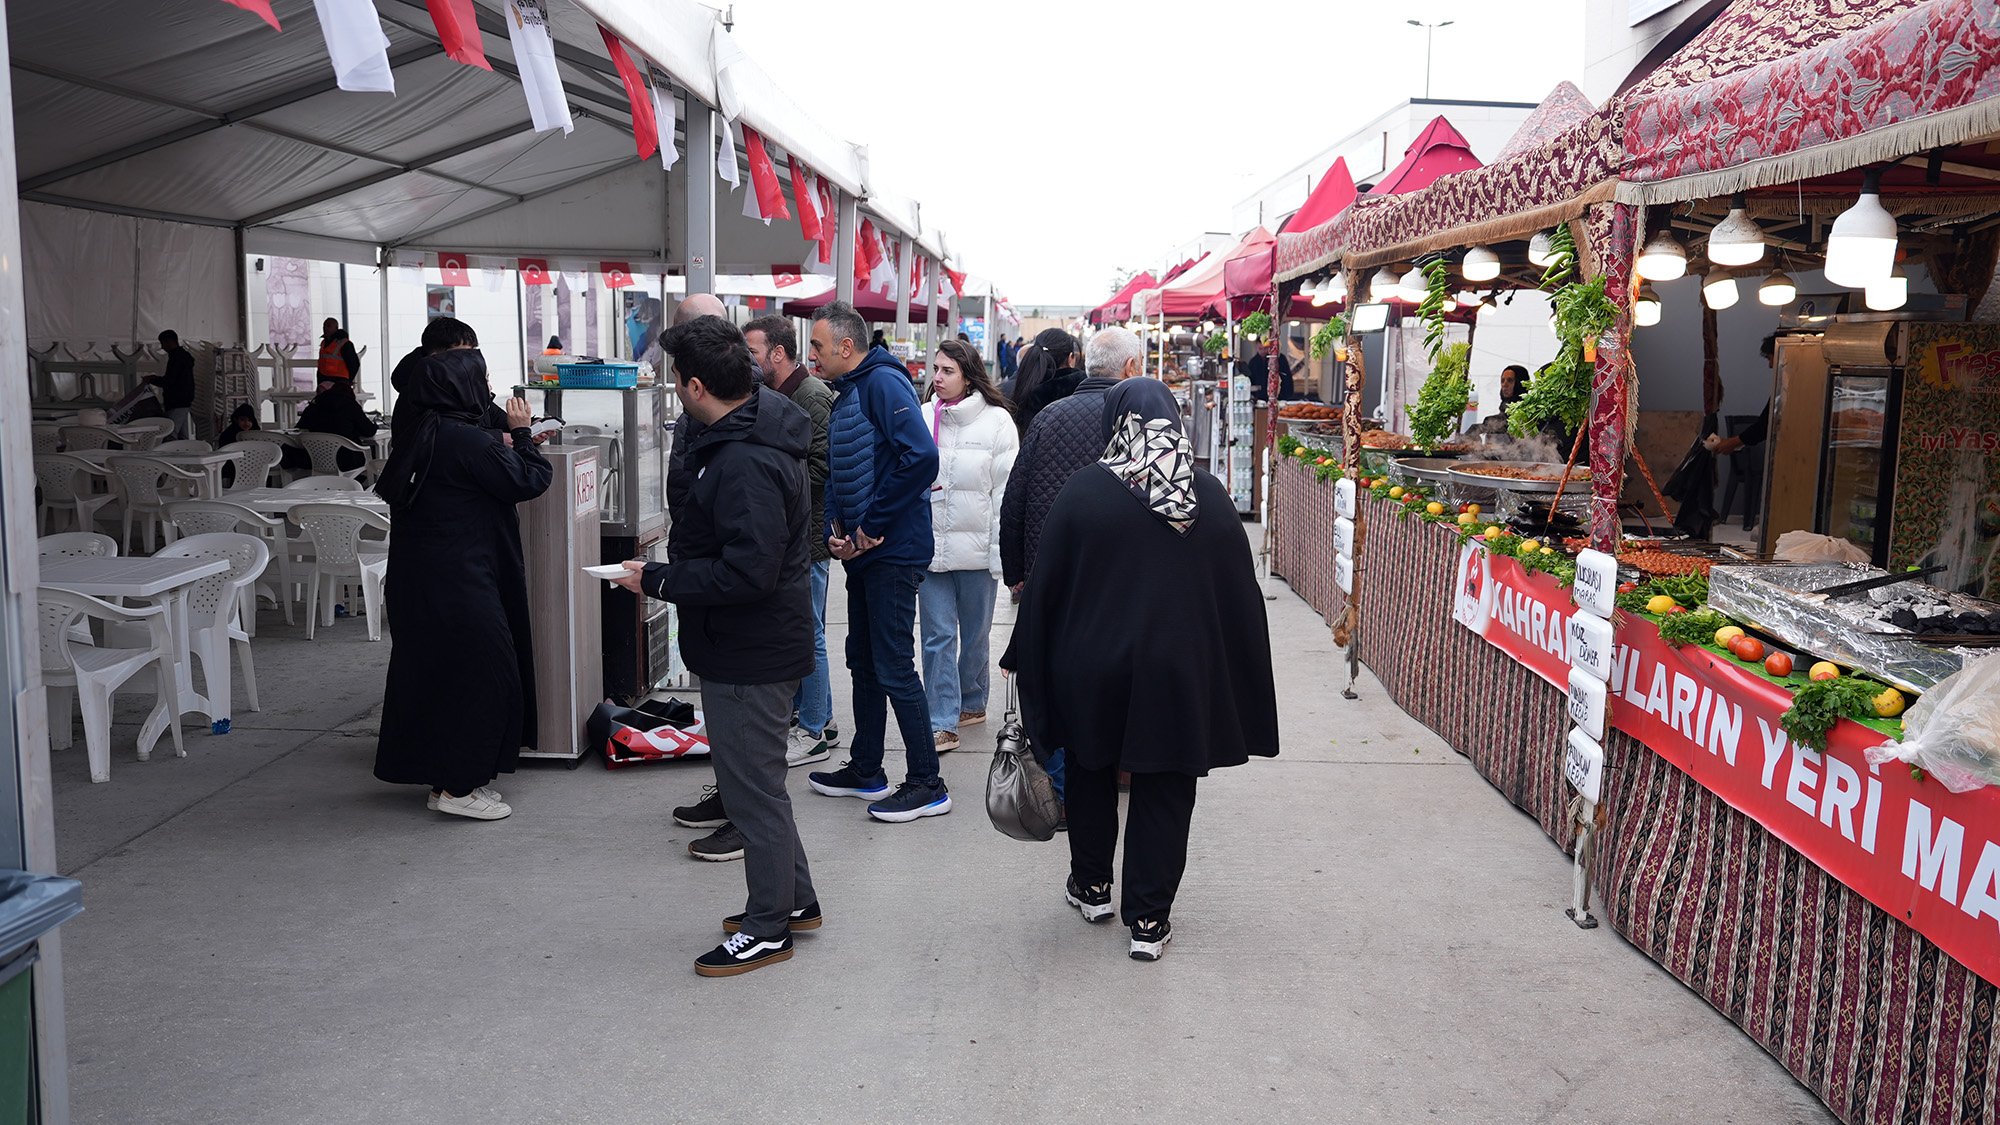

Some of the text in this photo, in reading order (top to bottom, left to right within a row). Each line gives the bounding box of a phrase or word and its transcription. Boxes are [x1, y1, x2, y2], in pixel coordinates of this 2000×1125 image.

[1920, 427, 2000, 455] iyi Yaş
[1490, 577, 1743, 767] KAHRANLARIN
[1756, 716, 1882, 855] YERİ
